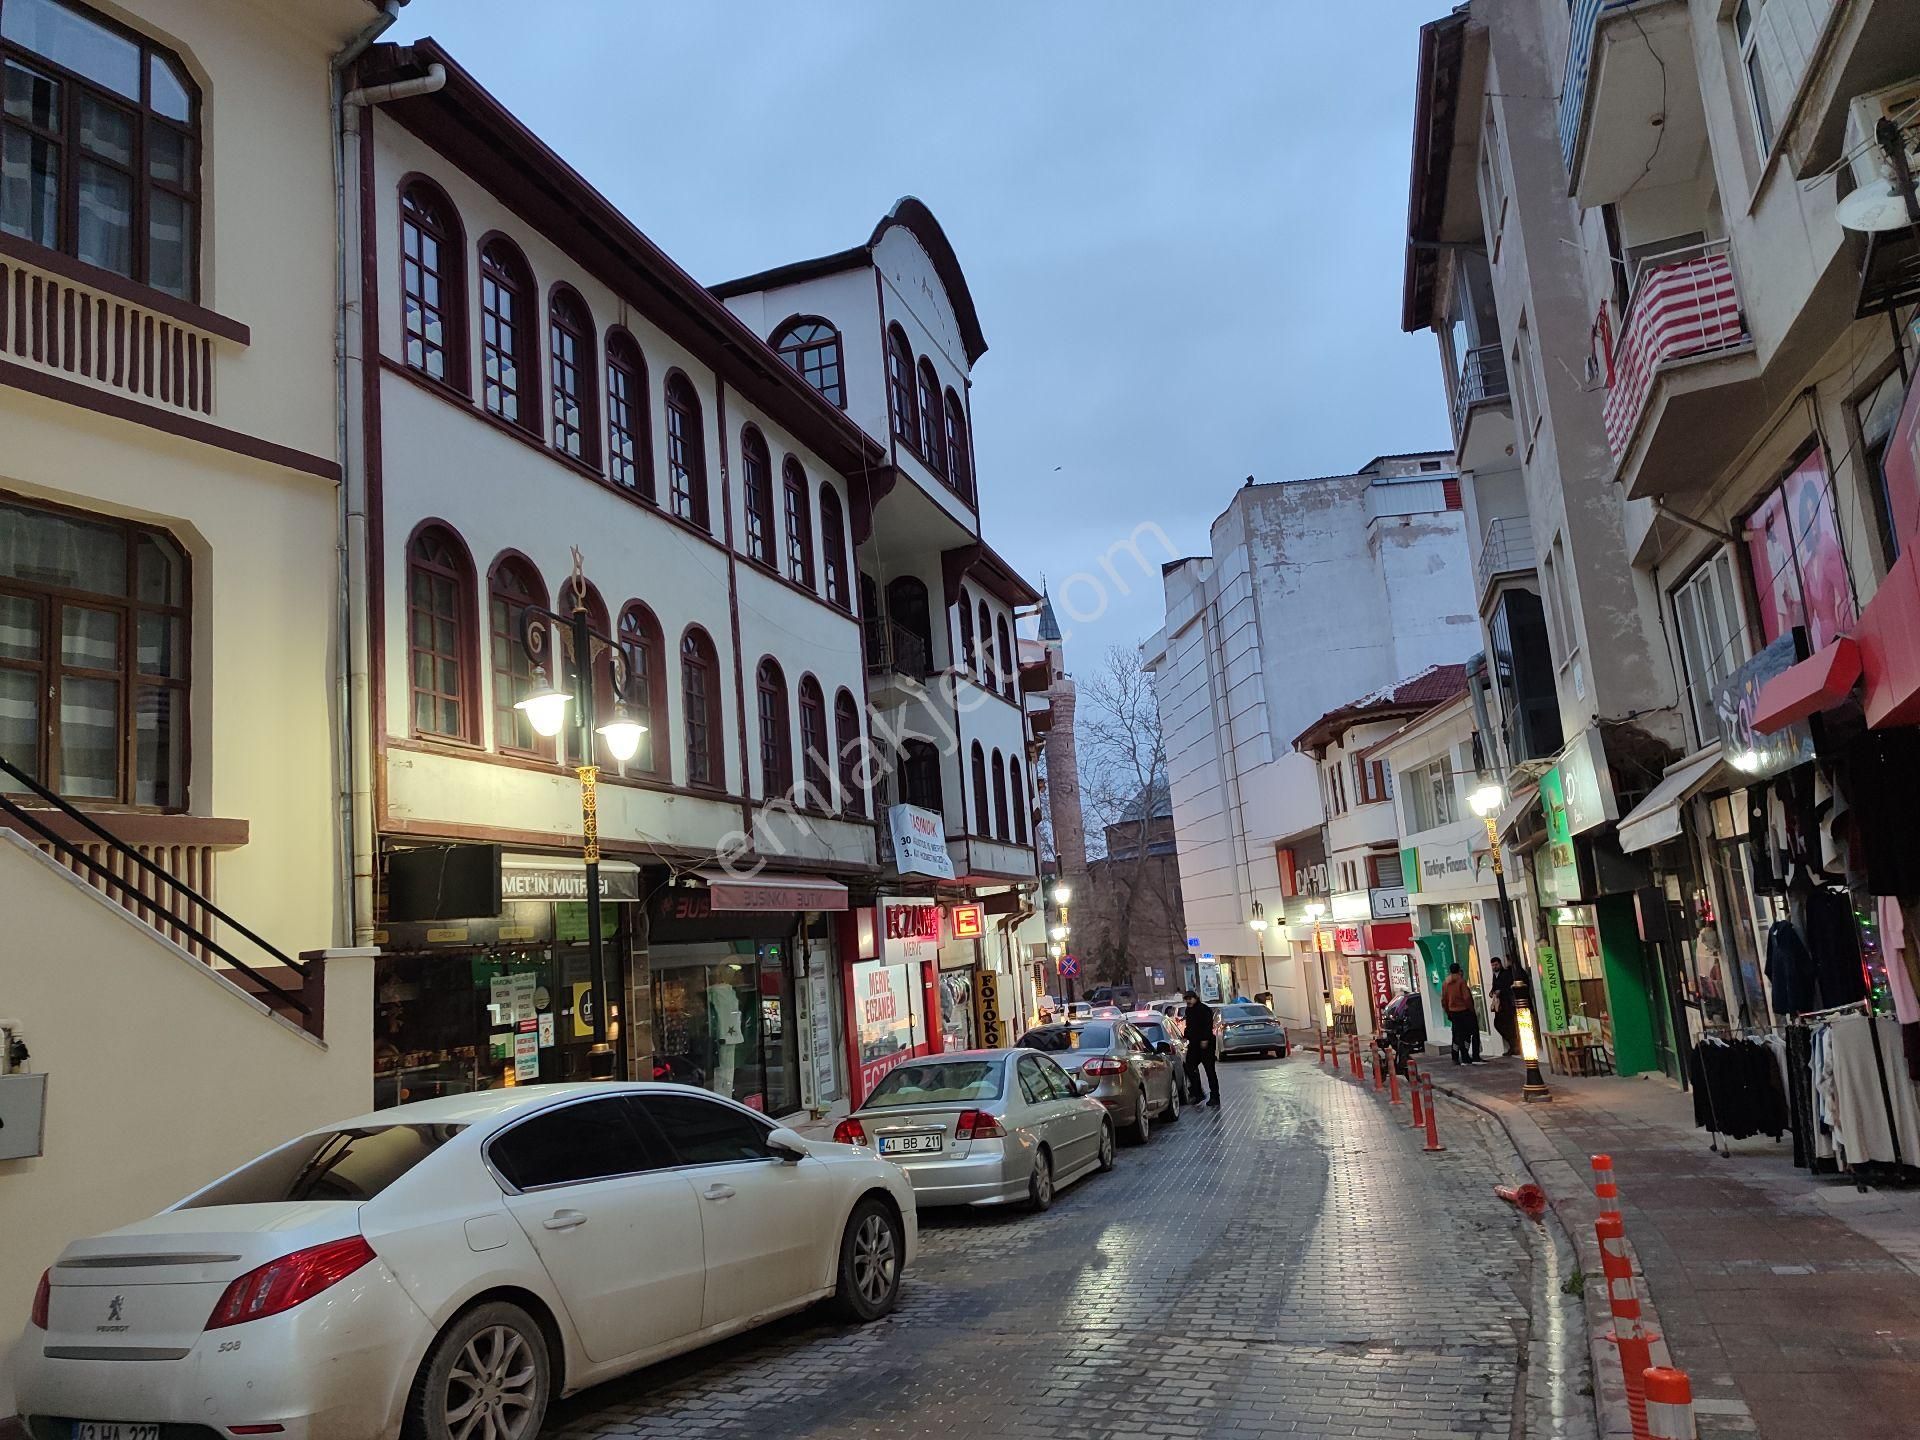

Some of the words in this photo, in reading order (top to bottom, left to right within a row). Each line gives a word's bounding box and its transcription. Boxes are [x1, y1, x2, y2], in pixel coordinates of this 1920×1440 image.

[901, 836, 911, 846] 30
[553, 875, 609, 895] MUTFĞI
[868, 970, 892, 996] MERVE
[865, 994, 897, 1024] ECZANESİ
[885, 1140, 896, 1150] 41
[903, 1138, 918, 1149] BB
[925, 1136, 940, 1148] 211
[218, 1341, 241, 1352] 508
